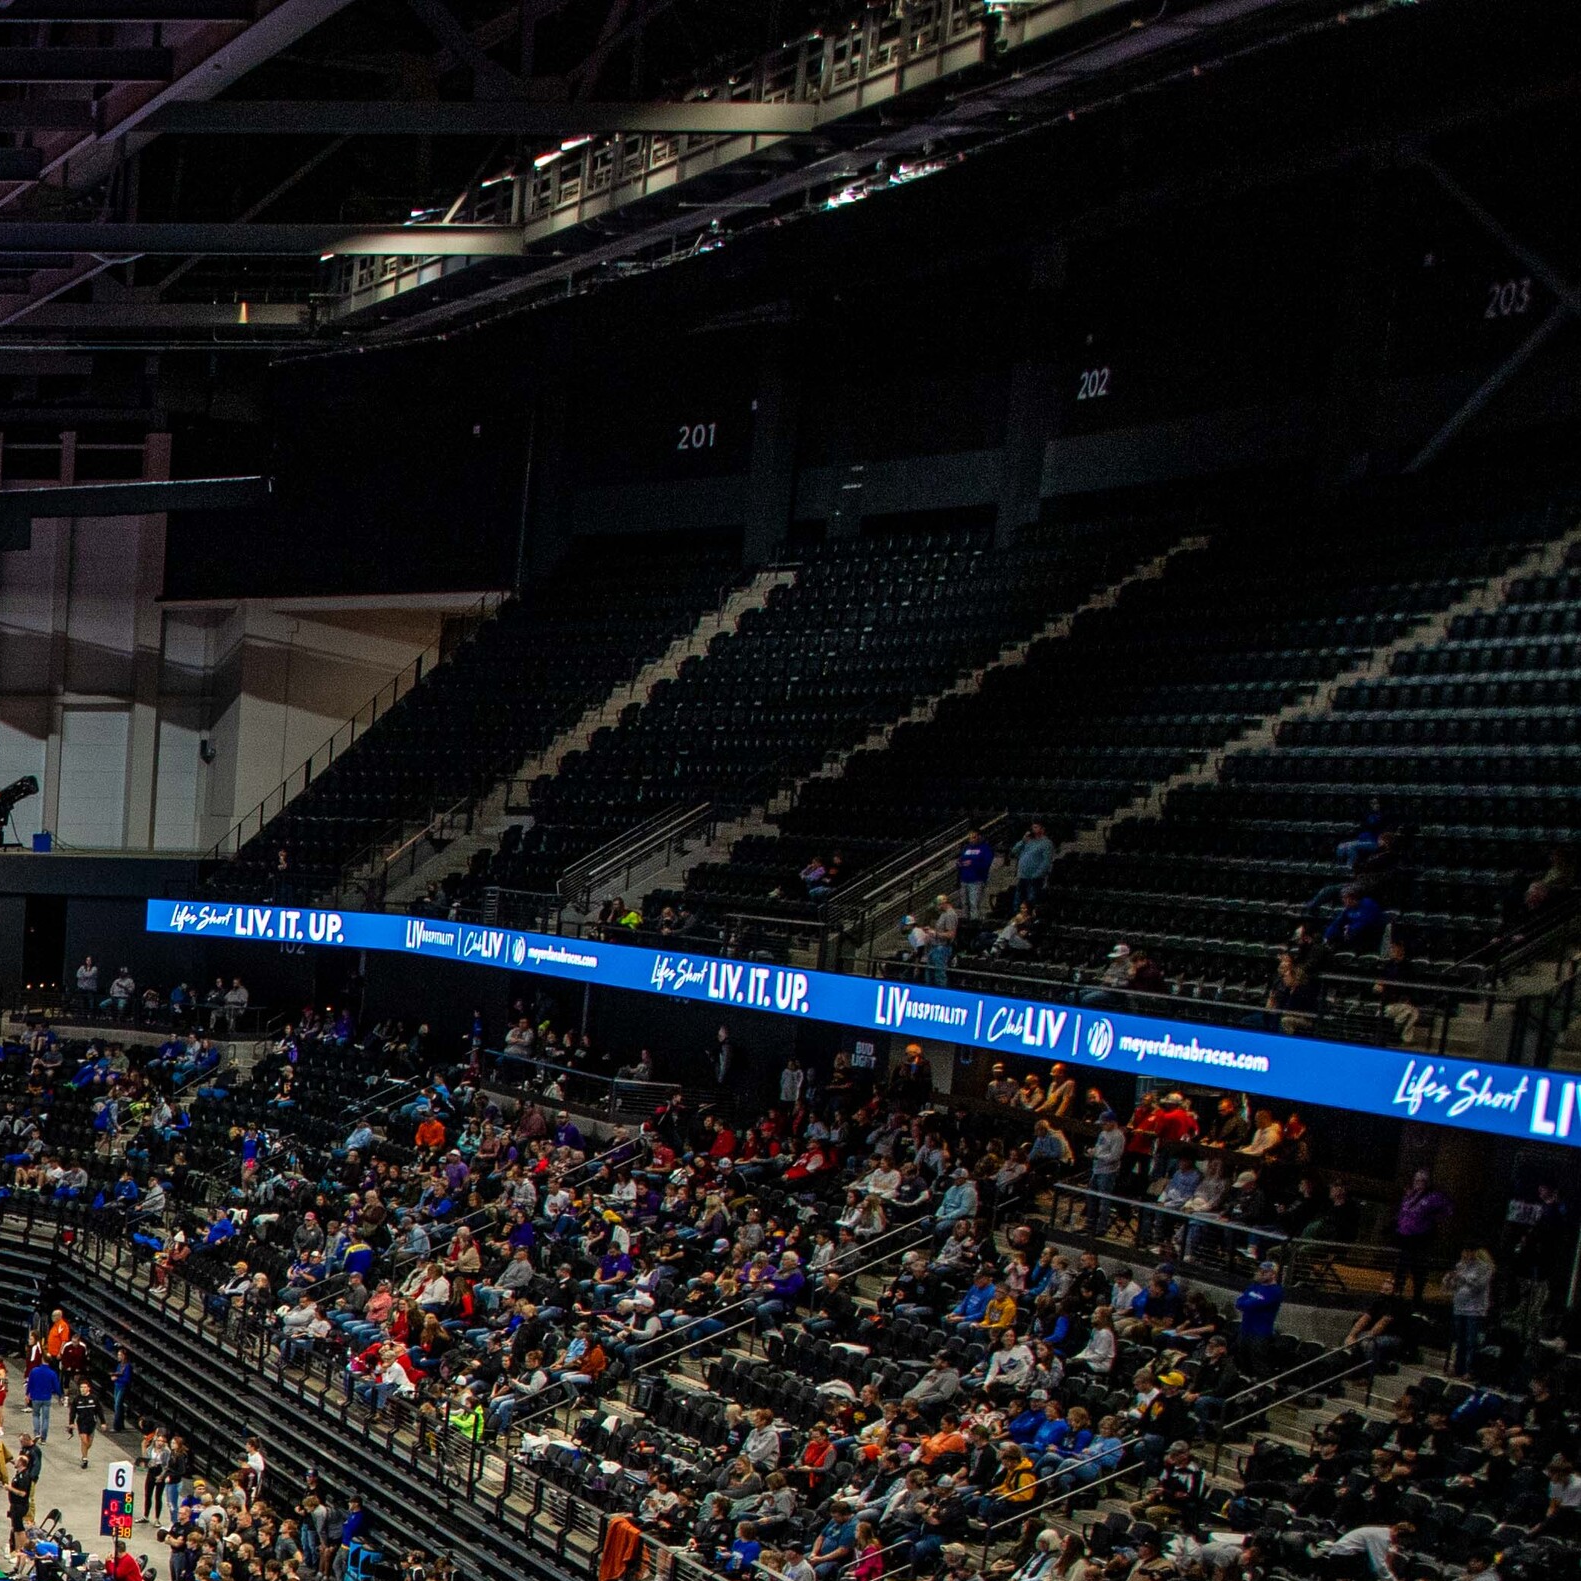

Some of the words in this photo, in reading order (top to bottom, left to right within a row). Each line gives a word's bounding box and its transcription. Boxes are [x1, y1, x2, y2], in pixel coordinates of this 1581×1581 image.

[1484, 278, 1532, 319] 203
[1078, 368, 1111, 401] 202
[676, 421, 718, 451] 201
[170, 903, 197, 932] Life's
[196, 905, 233, 930] Short
[235, 908, 273, 937] LIV.
[279, 911, 303, 940] IT.
[309, 912, 344, 943] UP.
[651, 955, 676, 991] Life's
[673, 958, 708, 990] Short
[708, 962, 744, 1003] LIV.
[747, 967, 770, 1007] IT.
[776, 971, 809, 1013] UP.
[1119, 1030, 1269, 1072] meyerdanabraces.com
[1393, 1059, 1451, 1115] Life's
[1446, 1069, 1529, 1117] Short
[1529, 1077, 1581, 1138] LI
[115, 1468, 125, 1488] 6
